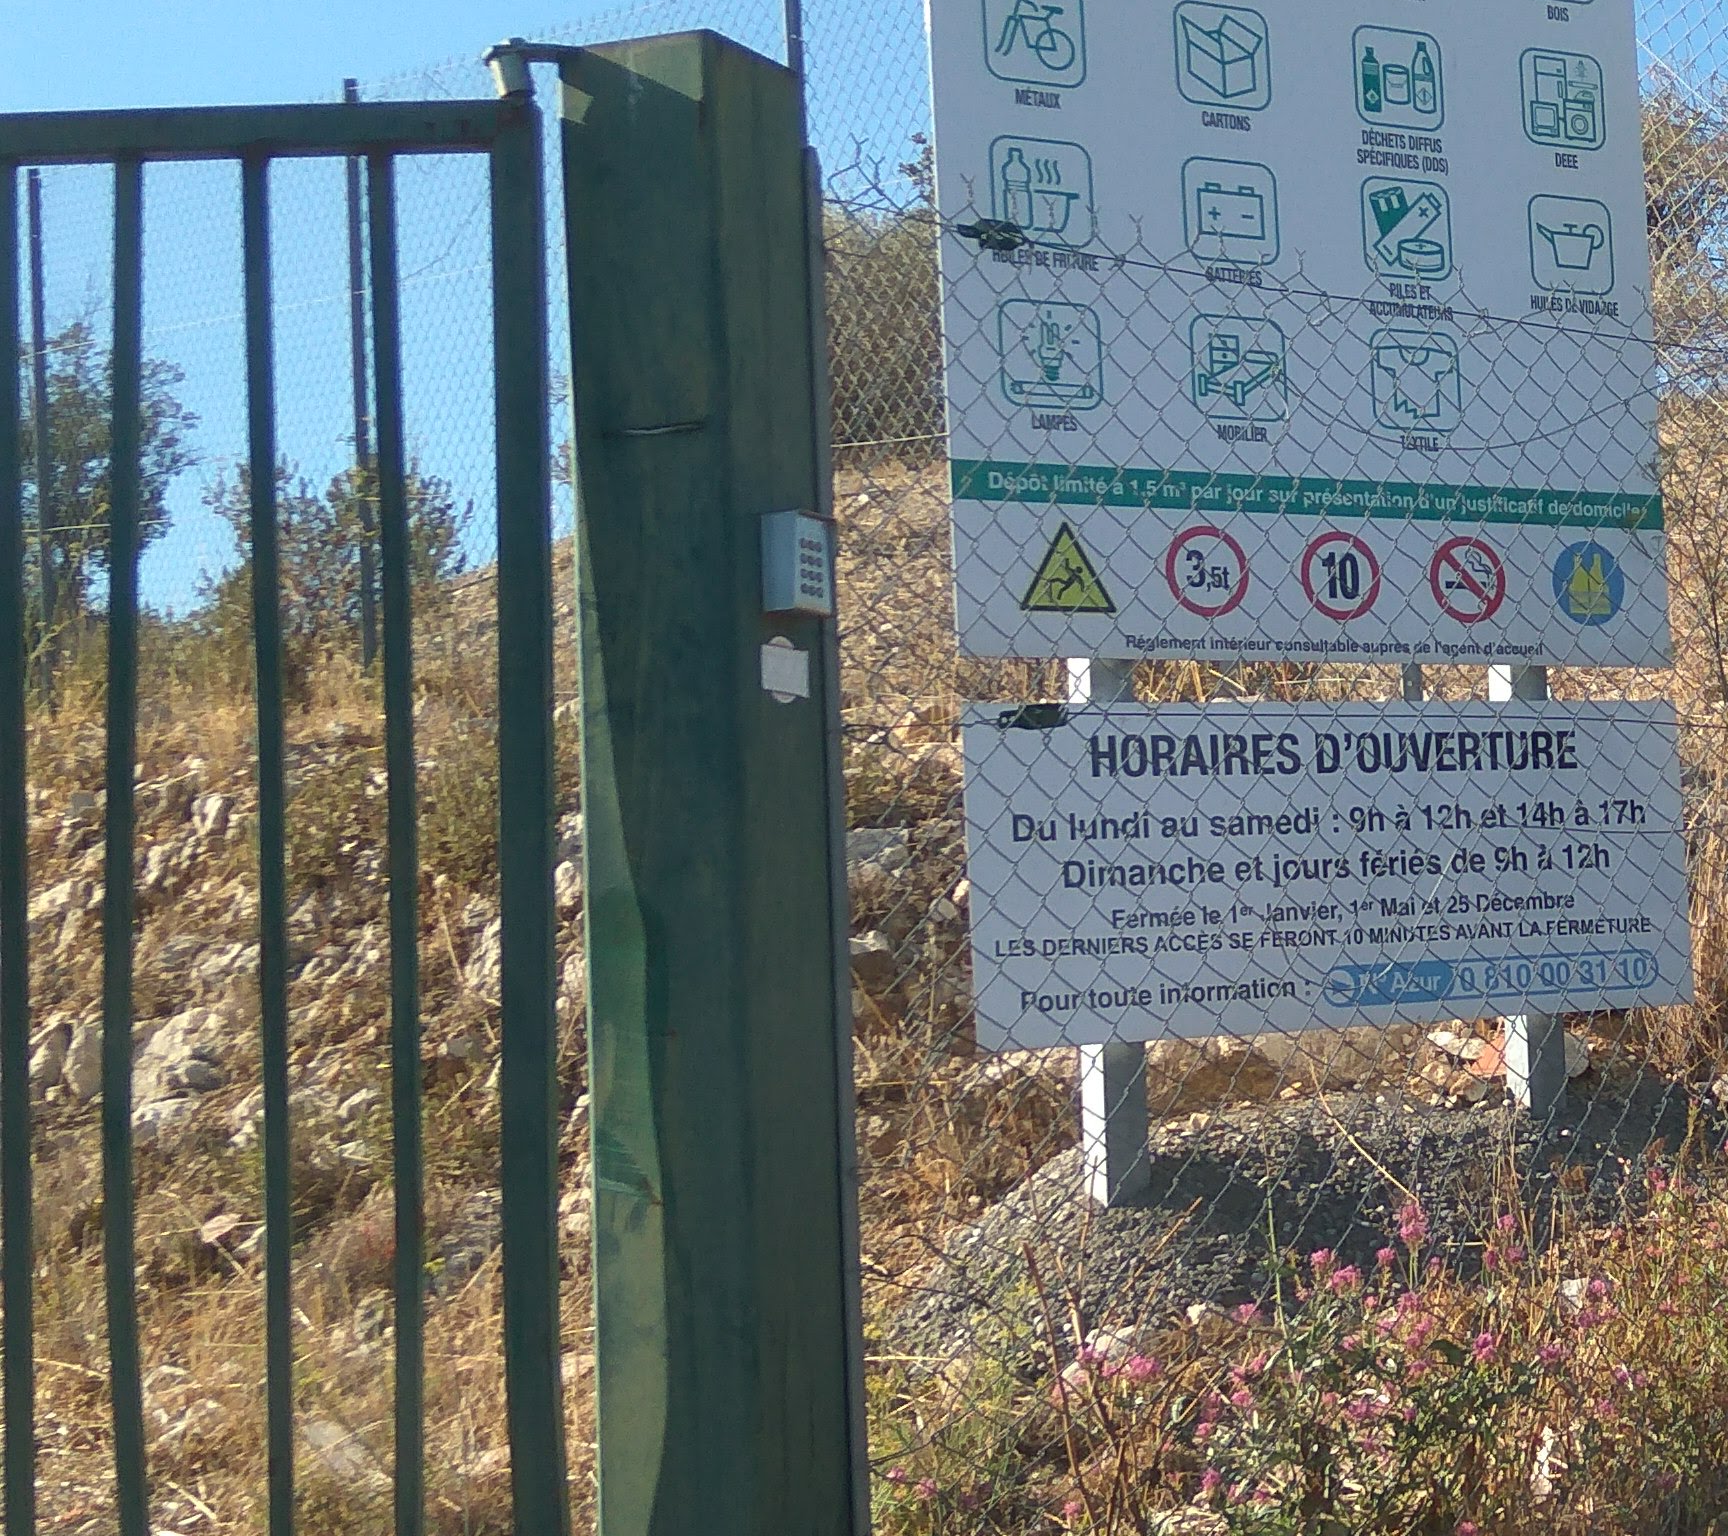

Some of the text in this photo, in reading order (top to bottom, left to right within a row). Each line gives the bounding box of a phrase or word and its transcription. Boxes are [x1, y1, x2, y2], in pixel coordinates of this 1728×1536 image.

[1547, 4, 1570, 22] BOIS
[1014, 86, 1061, 110] MÉTAUX
[1202, 110, 1252, 132] CARTONS
[1361, 128, 1443, 154] DÉCHETS DIFFUS
[1356, 147, 1449, 177] SPÉCIFIQUES (DDS)
[1555, 152, 1579, 170] DEEE
[1205, 265, 1262, 288] BATTERIES
[1389, 282, 1432, 301] PILES ET
[1031, 414, 1078, 432] LAMPES
[1217, 425, 1268, 443] MOBILIER
[988, 470, 1048, 496] Dépôt
[1053, 473, 1108, 496] limité
[1191, 484, 1222, 504] par
[1226, 482, 1263, 506] jour
[1268, 487, 1298, 504] sur
[1303, 486, 1413, 510] présentation
[1420, 491, 1456, 512] d'un
[1548, 498, 1570, 516] de
[1186, 549, 1230, 592] 3,5t
[1321, 551, 1360, 600] 10
[1210, 636, 1271, 652] intérieur
[1276, 638, 1358, 654] consultable
[1413, 642, 1431, 654] de
[1434, 641, 1482, 658] l'agent
[1484, 642, 1544, 656] d'accueil
[1090, 730, 1578, 778] HORAIRES D'OUVERTURE
[1012, 812, 1057, 843] Du
[1069, 808, 1150, 841] lundi
[1161, 814, 1199, 839] au
[1209, 806, 1319, 838] samedi
[1349, 805, 1385, 833] 9h
[1394, 803, 1411, 831] à
[1422, 803, 1472, 830] 12h
[1481, 804, 1507, 829] et
[1517, 802, 1565, 827] 14h
[1574, 799, 1590, 826] à
[1598, 799, 1646, 825] 17h
[1063, 843, 1610, 889] Dimanche et jours fériés de 9h à 12h
[1112, 905, 1196, 930] Fermée
[1202, 905, 1222, 925] le
[1264, 900, 1344, 924] Janvier,
[1380, 896, 1416, 918] Mai
[1422, 897, 1443, 916] et
[1447, 894, 1470, 914] 25
[1476, 890, 1576, 913] Décembre
[994, 916, 1652, 958] LES DERNIERS ACCÈS SE FERONT 10 MINUTES AVANT LA FERMETURE
[1388, 970, 1442, 994] Azur
[1461, 965, 1476, 992] 0
[1021, 989, 1082, 1014] Pour
[1088, 986, 1153, 1010] toute
[1160, 977, 1297, 1006] information
